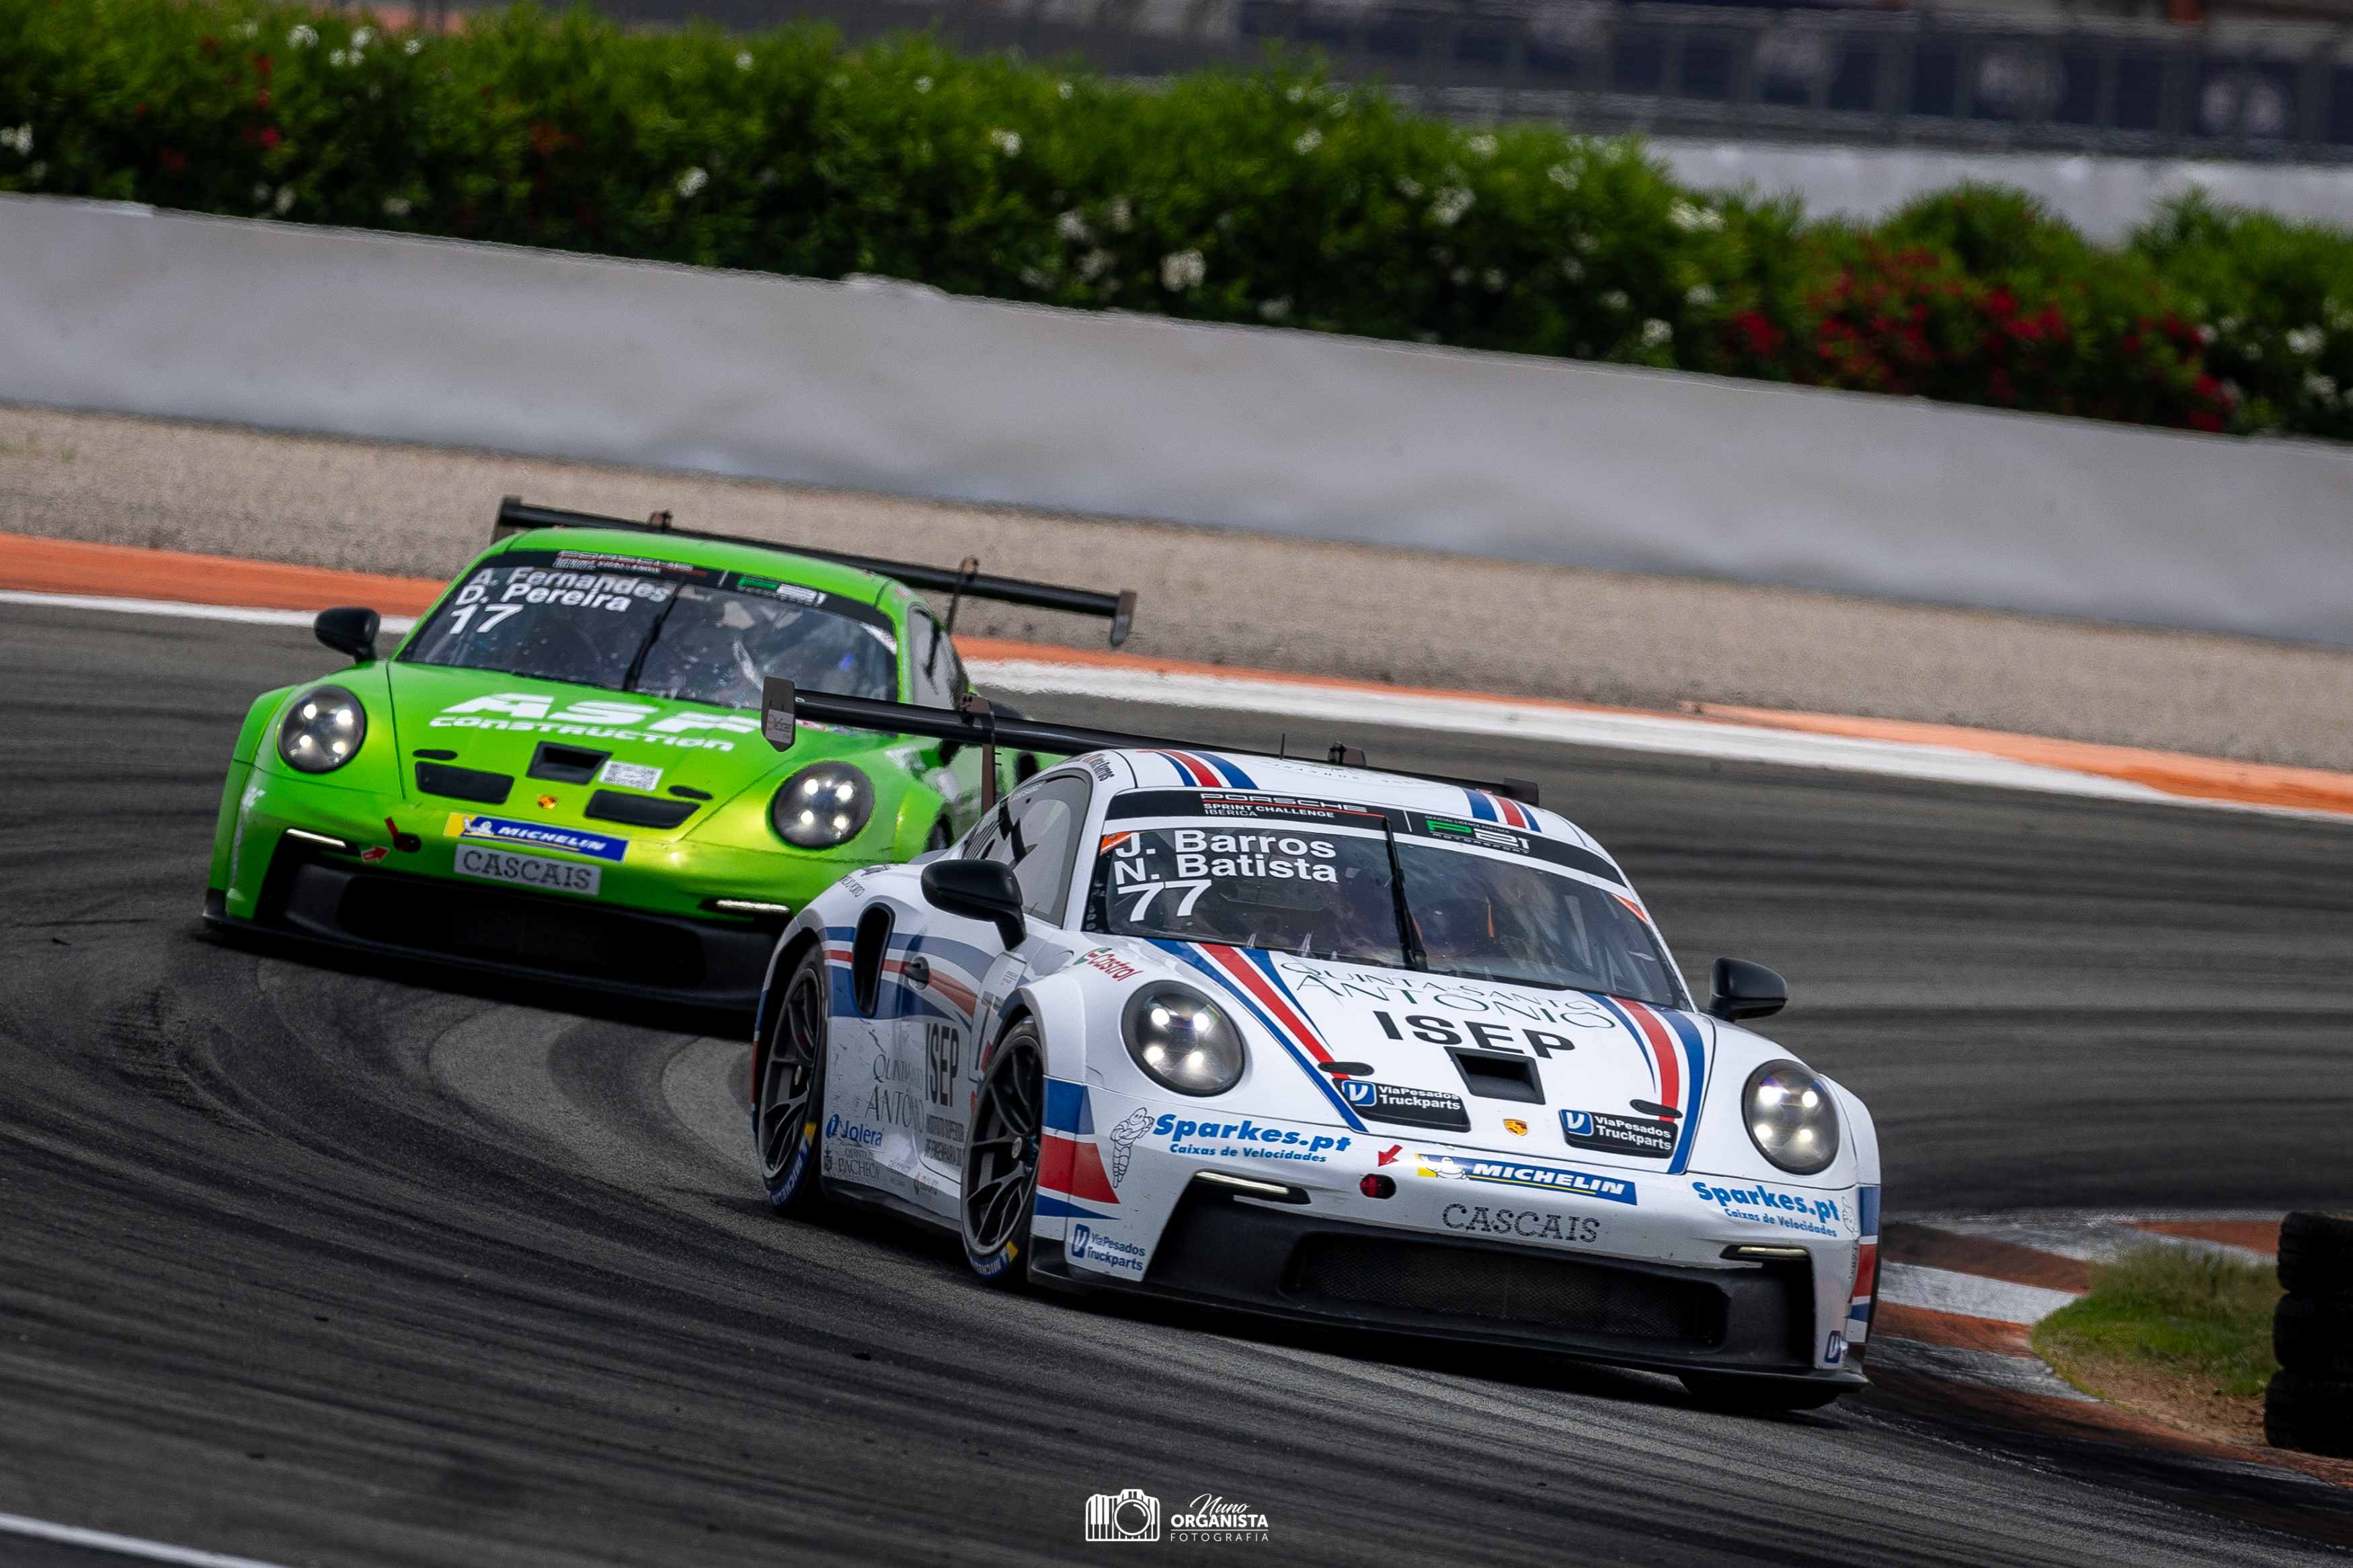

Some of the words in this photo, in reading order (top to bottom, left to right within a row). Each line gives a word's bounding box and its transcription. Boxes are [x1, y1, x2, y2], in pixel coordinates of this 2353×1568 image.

[454, 583, 489, 606] D.
[500, 583, 633, 612] Pereira
[470, 568, 498, 587] A.
[506, 566, 669, 603] Fernandes
[449, 604, 524, 635] 17
[1200, 794, 1367, 813] PORSCHE
[1204, 803, 1253, 812] SPRINT
[1256, 806, 1334, 818] CHALLENGE
[497, 826, 608, 850] MICHELIN
[1482, 825, 1510, 833] PARTNER
[1115, 832, 1156, 858] J.
[1174, 830, 1337, 858] Barros
[463, 850, 592, 889] CASCAIS
[1113, 858, 1160, 885] N.
[1176, 854, 1339, 883] Batista
[1118, 879, 1211, 922] 77
[1088, 953, 1144, 982] Castrol
[1281, 962, 1447, 992] QUINTA
[1460, 985, 1599, 1009] SANTO
[1372, 1010, 1576, 1059] ISEP
[925, 1022, 960, 1108] ISEP
[1379, 1085, 1460, 1100] ViaPesados
[1379, 1094, 1461, 1110] Truckparts
[1153, 1113, 1352, 1152] Sparkes.pt
[1594, 1116, 1672, 1139] ViaPesados
[1596, 1125, 1672, 1151] Truckparts
[1169, 1143, 1215, 1156] Caixas
[1220, 1145, 1238, 1157] de
[1243, 1147, 1327, 1163] Velocidades
[1472, 1163, 1626, 1195] MICHELIN
[1442, 1203, 1600, 1243] CASCAIS
[1724, 1208, 1760, 1223] Caixas
[1763, 1213, 1776, 1225] de
[1777, 1216, 1837, 1237] Velocidades
[1087, 1246, 1144, 1271] Truckparts
[1092, 1232, 1146, 1257] ViaPesados
